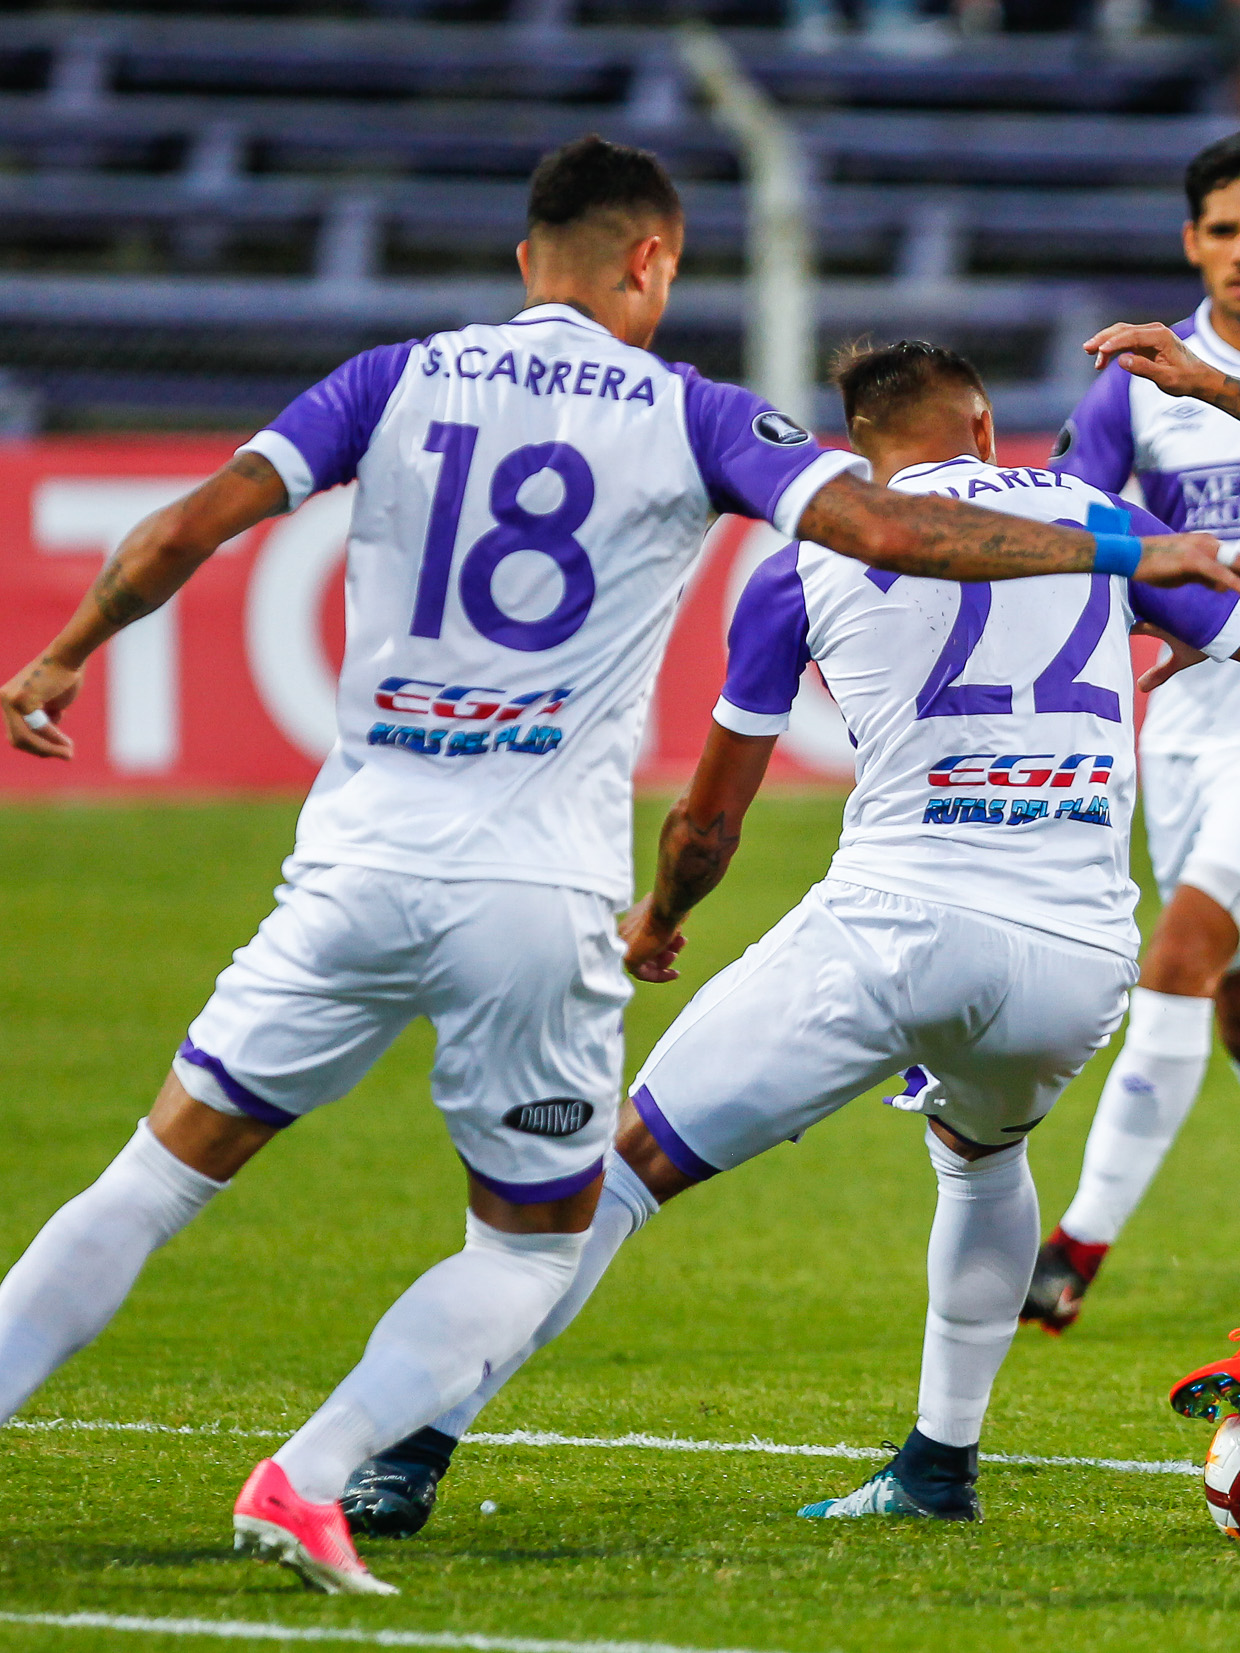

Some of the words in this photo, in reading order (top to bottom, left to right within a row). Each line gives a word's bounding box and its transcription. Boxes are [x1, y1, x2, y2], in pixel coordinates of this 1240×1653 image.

[409, 419, 596, 652] 18
[864, 517, 1122, 723] 22
[373, 676, 576, 722] EGA
[928, 753, 1114, 788] EGA
[921, 797, 1007, 824] RUTAS
[1006, 799, 1049, 826] DEL
[1053, 795, 1113, 828] PLAT
